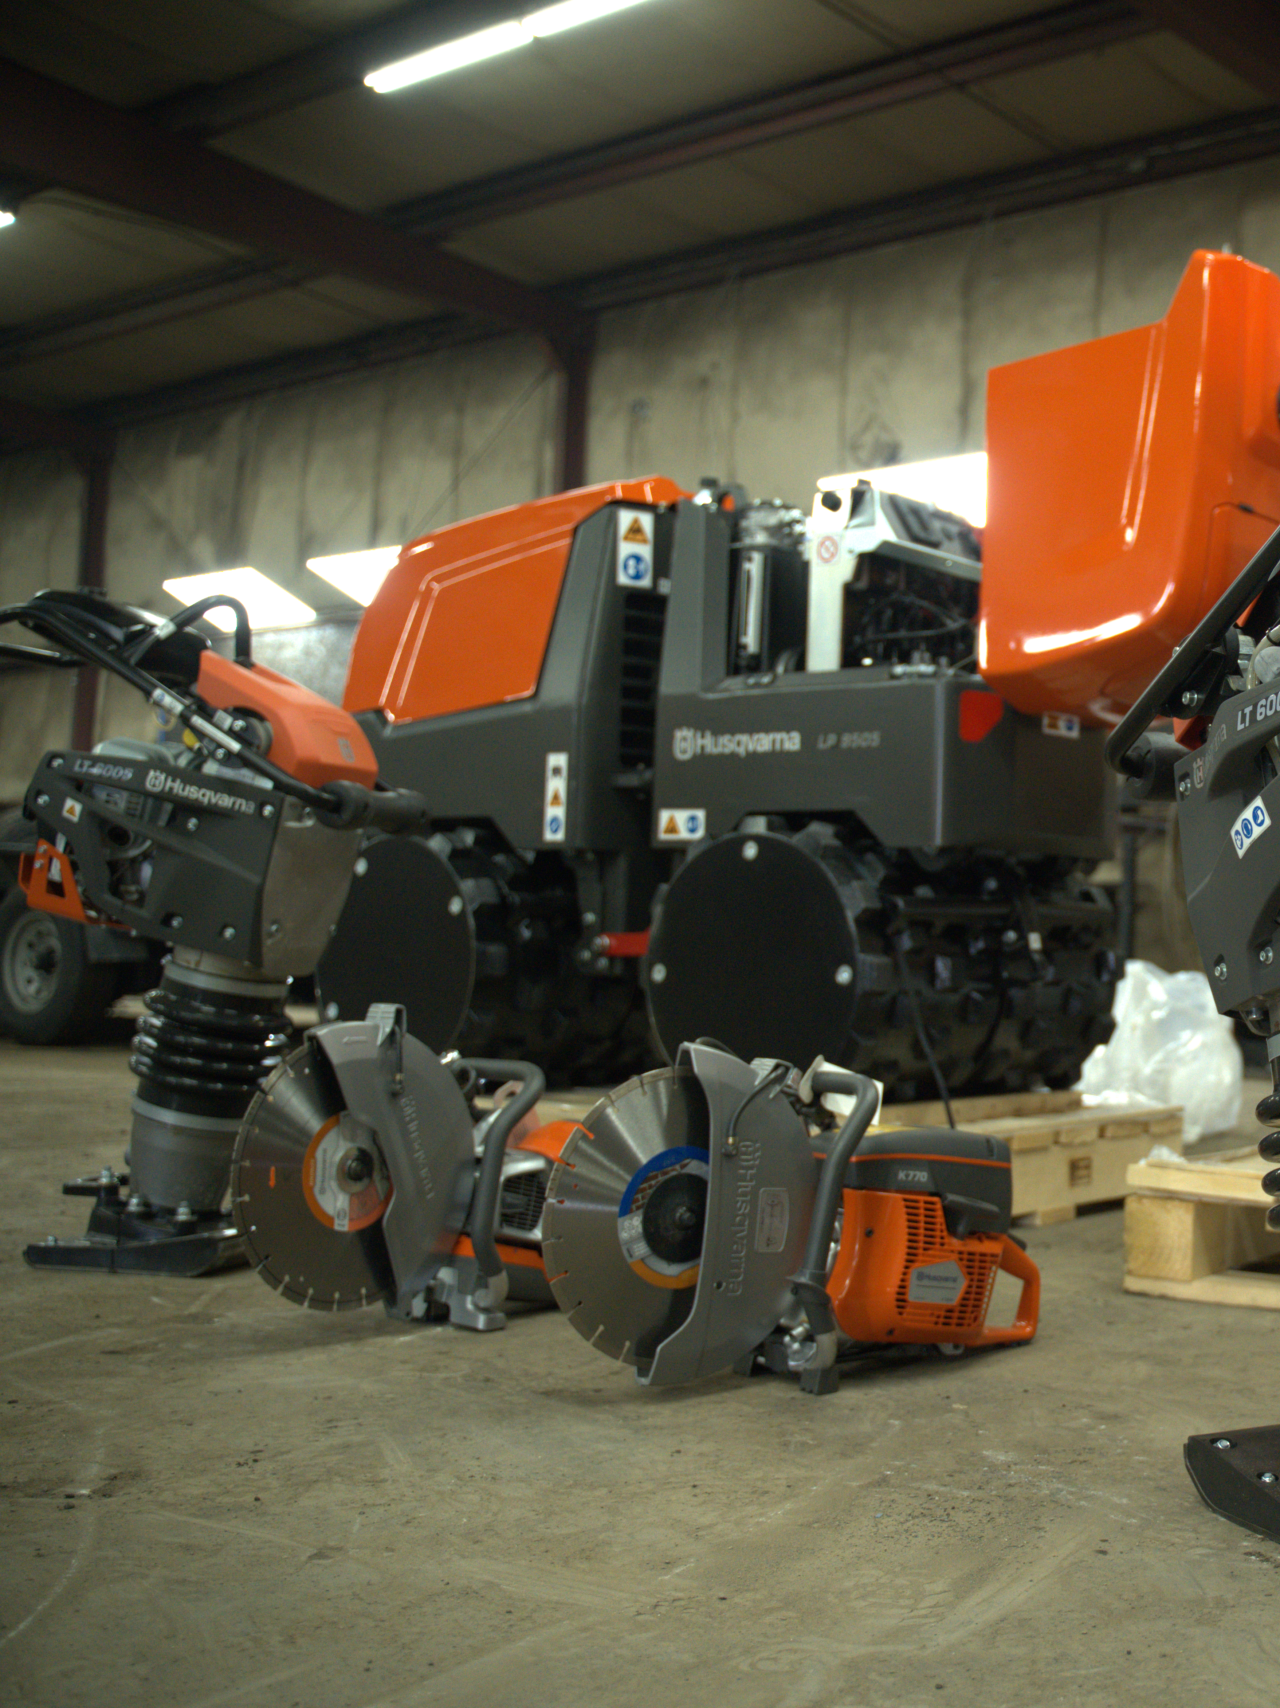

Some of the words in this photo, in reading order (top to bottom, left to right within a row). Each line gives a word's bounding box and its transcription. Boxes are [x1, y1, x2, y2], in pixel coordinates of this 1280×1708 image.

[1236, 705, 1253, 731] LT
[695, 729, 801, 758] Husqvarna
[164, 775, 256, 816] Husqvarna
[727, 1166, 756, 1296] Husqvarna
